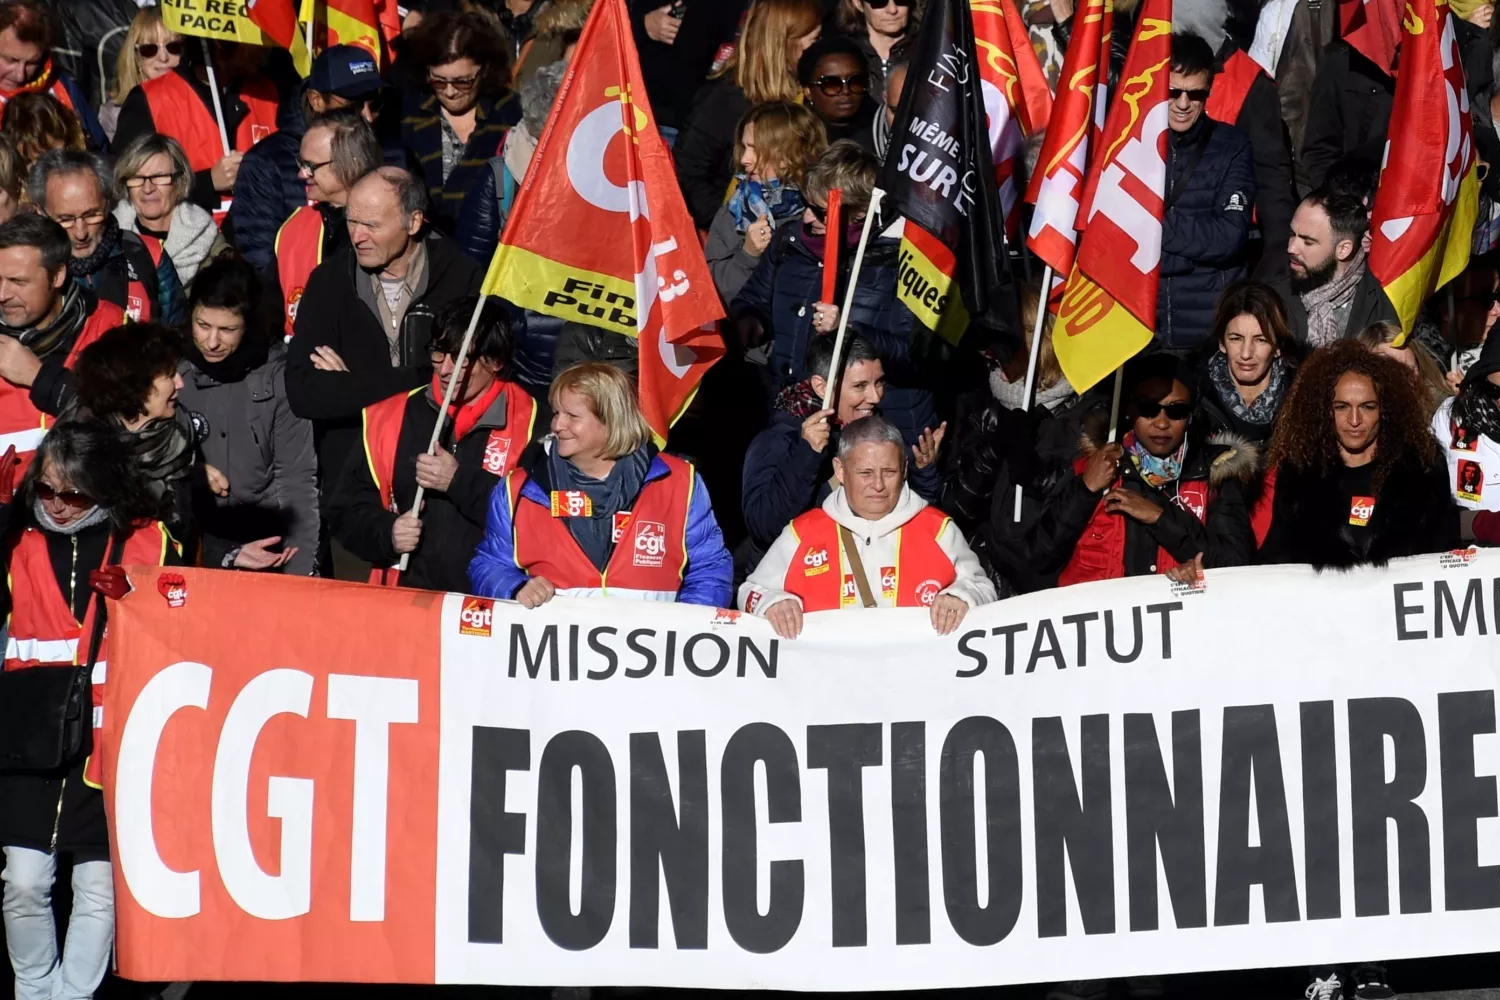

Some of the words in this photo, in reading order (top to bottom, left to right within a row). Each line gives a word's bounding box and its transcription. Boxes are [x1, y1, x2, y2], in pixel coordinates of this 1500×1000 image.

[180, 13, 237, 35] PACA
[896, 143, 958, 199] SUR
[566, 490, 585, 517] cgt
[1350, 504, 1375, 519] cgt
[635, 534, 666, 555] cgt
[804, 549, 828, 567] cgt
[461, 607, 492, 628] cgt
[508, 623, 779, 681] MISSION
[956, 602, 1183, 678] STATUT
[119, 660, 419, 923] CGT
